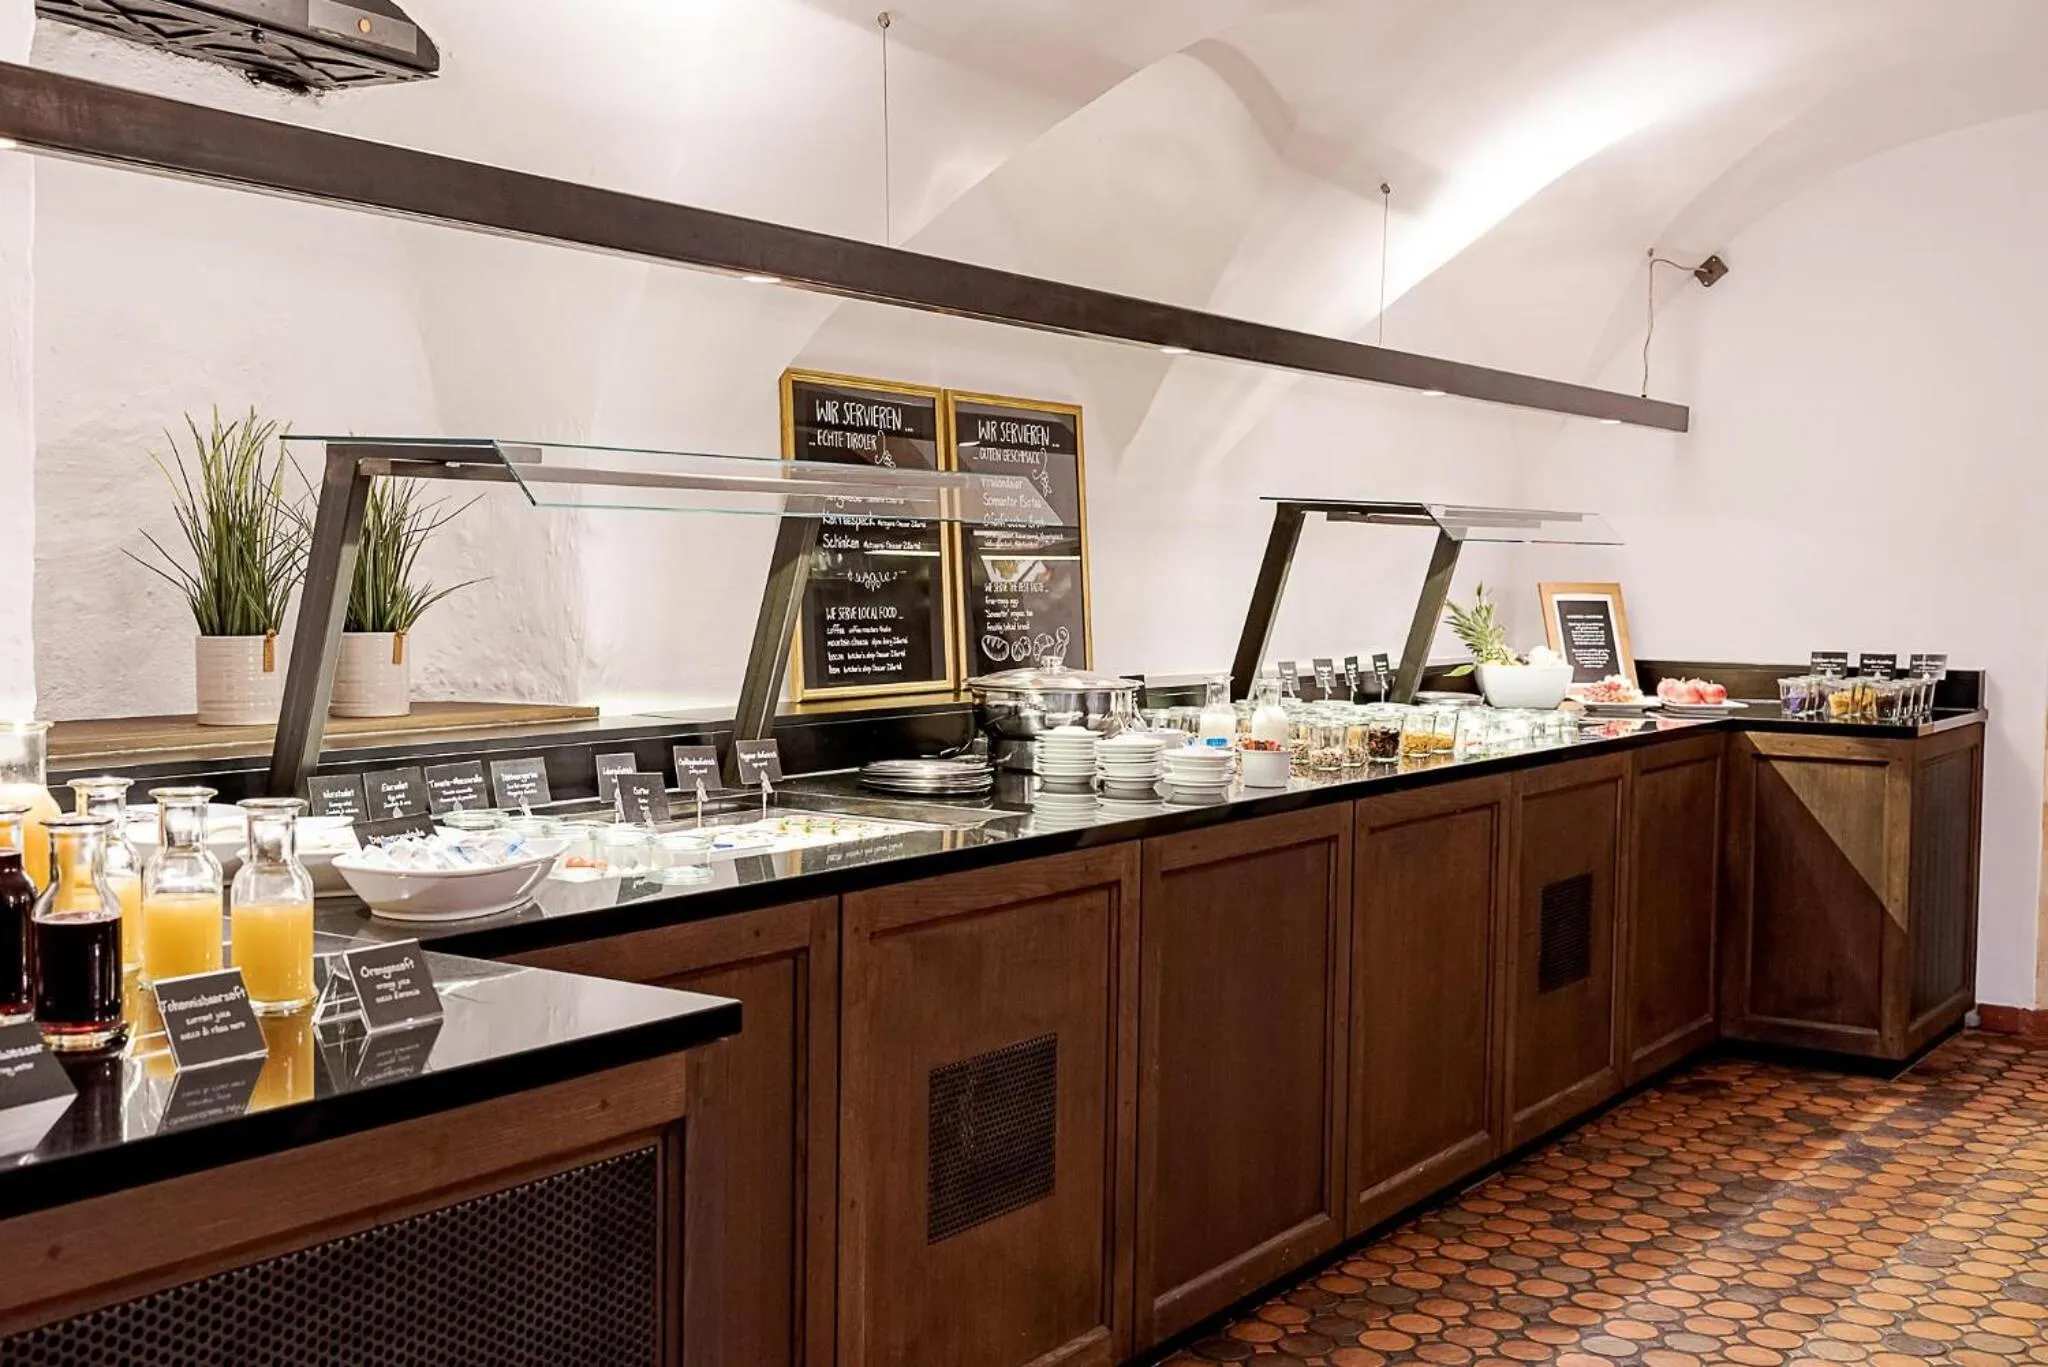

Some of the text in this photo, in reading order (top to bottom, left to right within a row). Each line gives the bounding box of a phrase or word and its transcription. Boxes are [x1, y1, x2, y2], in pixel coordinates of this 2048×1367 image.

[816, 399, 839, 425] WIR
[843, 402, 902, 431] SERVIEREN
[845, 432, 877, 450] TIROLER
[978, 420, 998, 443] WIR
[1000, 421, 1050, 446] SERVIEREN
[822, 534, 860, 549] Schinken
[825, 607, 837, 620] WE
[858, 606, 879, 620] LOCAL
[879, 606, 898, 619] FOOD
[360, 956, 415, 979] Orangensaft
